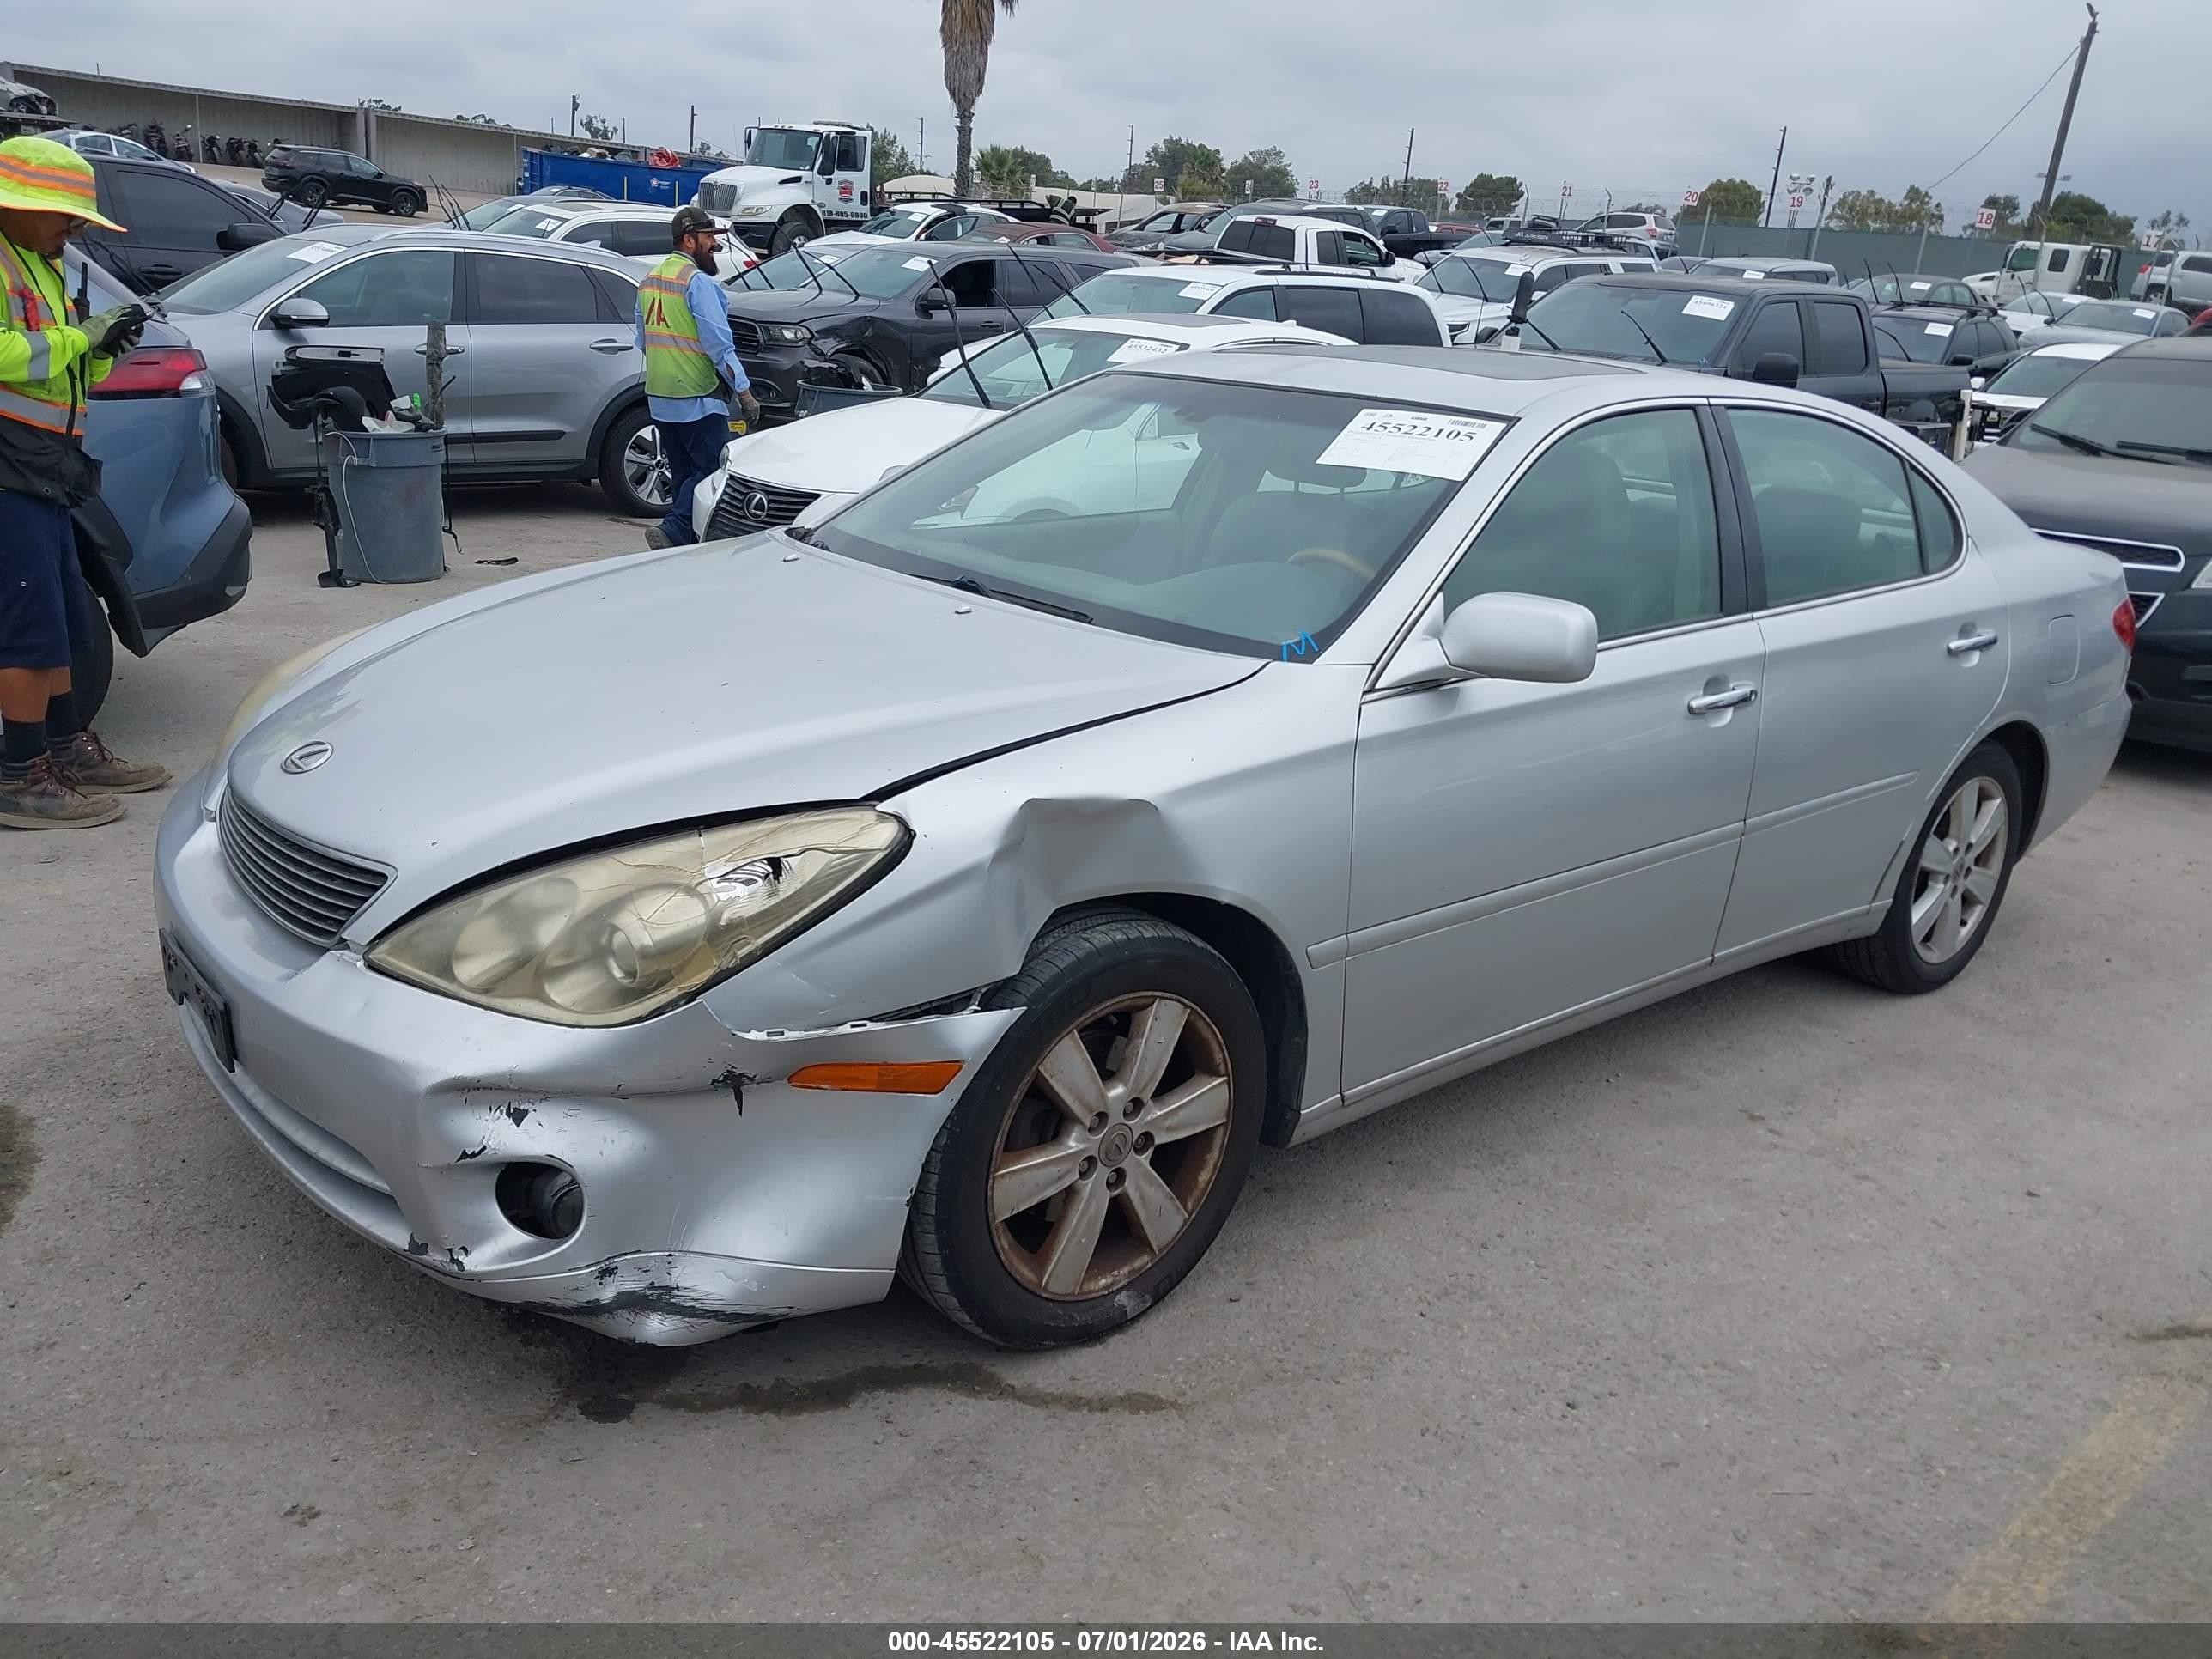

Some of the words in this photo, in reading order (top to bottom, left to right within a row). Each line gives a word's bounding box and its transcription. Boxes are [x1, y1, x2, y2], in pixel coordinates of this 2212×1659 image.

[1155, 179, 1164, 190] 25
[1309, 180, 1320, 190] 23
[1438, 181, 1449, 191] 22
[1561, 185, 1573, 197] 21
[1684, 191, 1699, 203] 20
[1790, 196, 1804, 208] 19
[1978, 211, 1994, 225] 18
[2142, 234, 2164, 248] 17
[1361, 421, 1478, 442] 45522105
